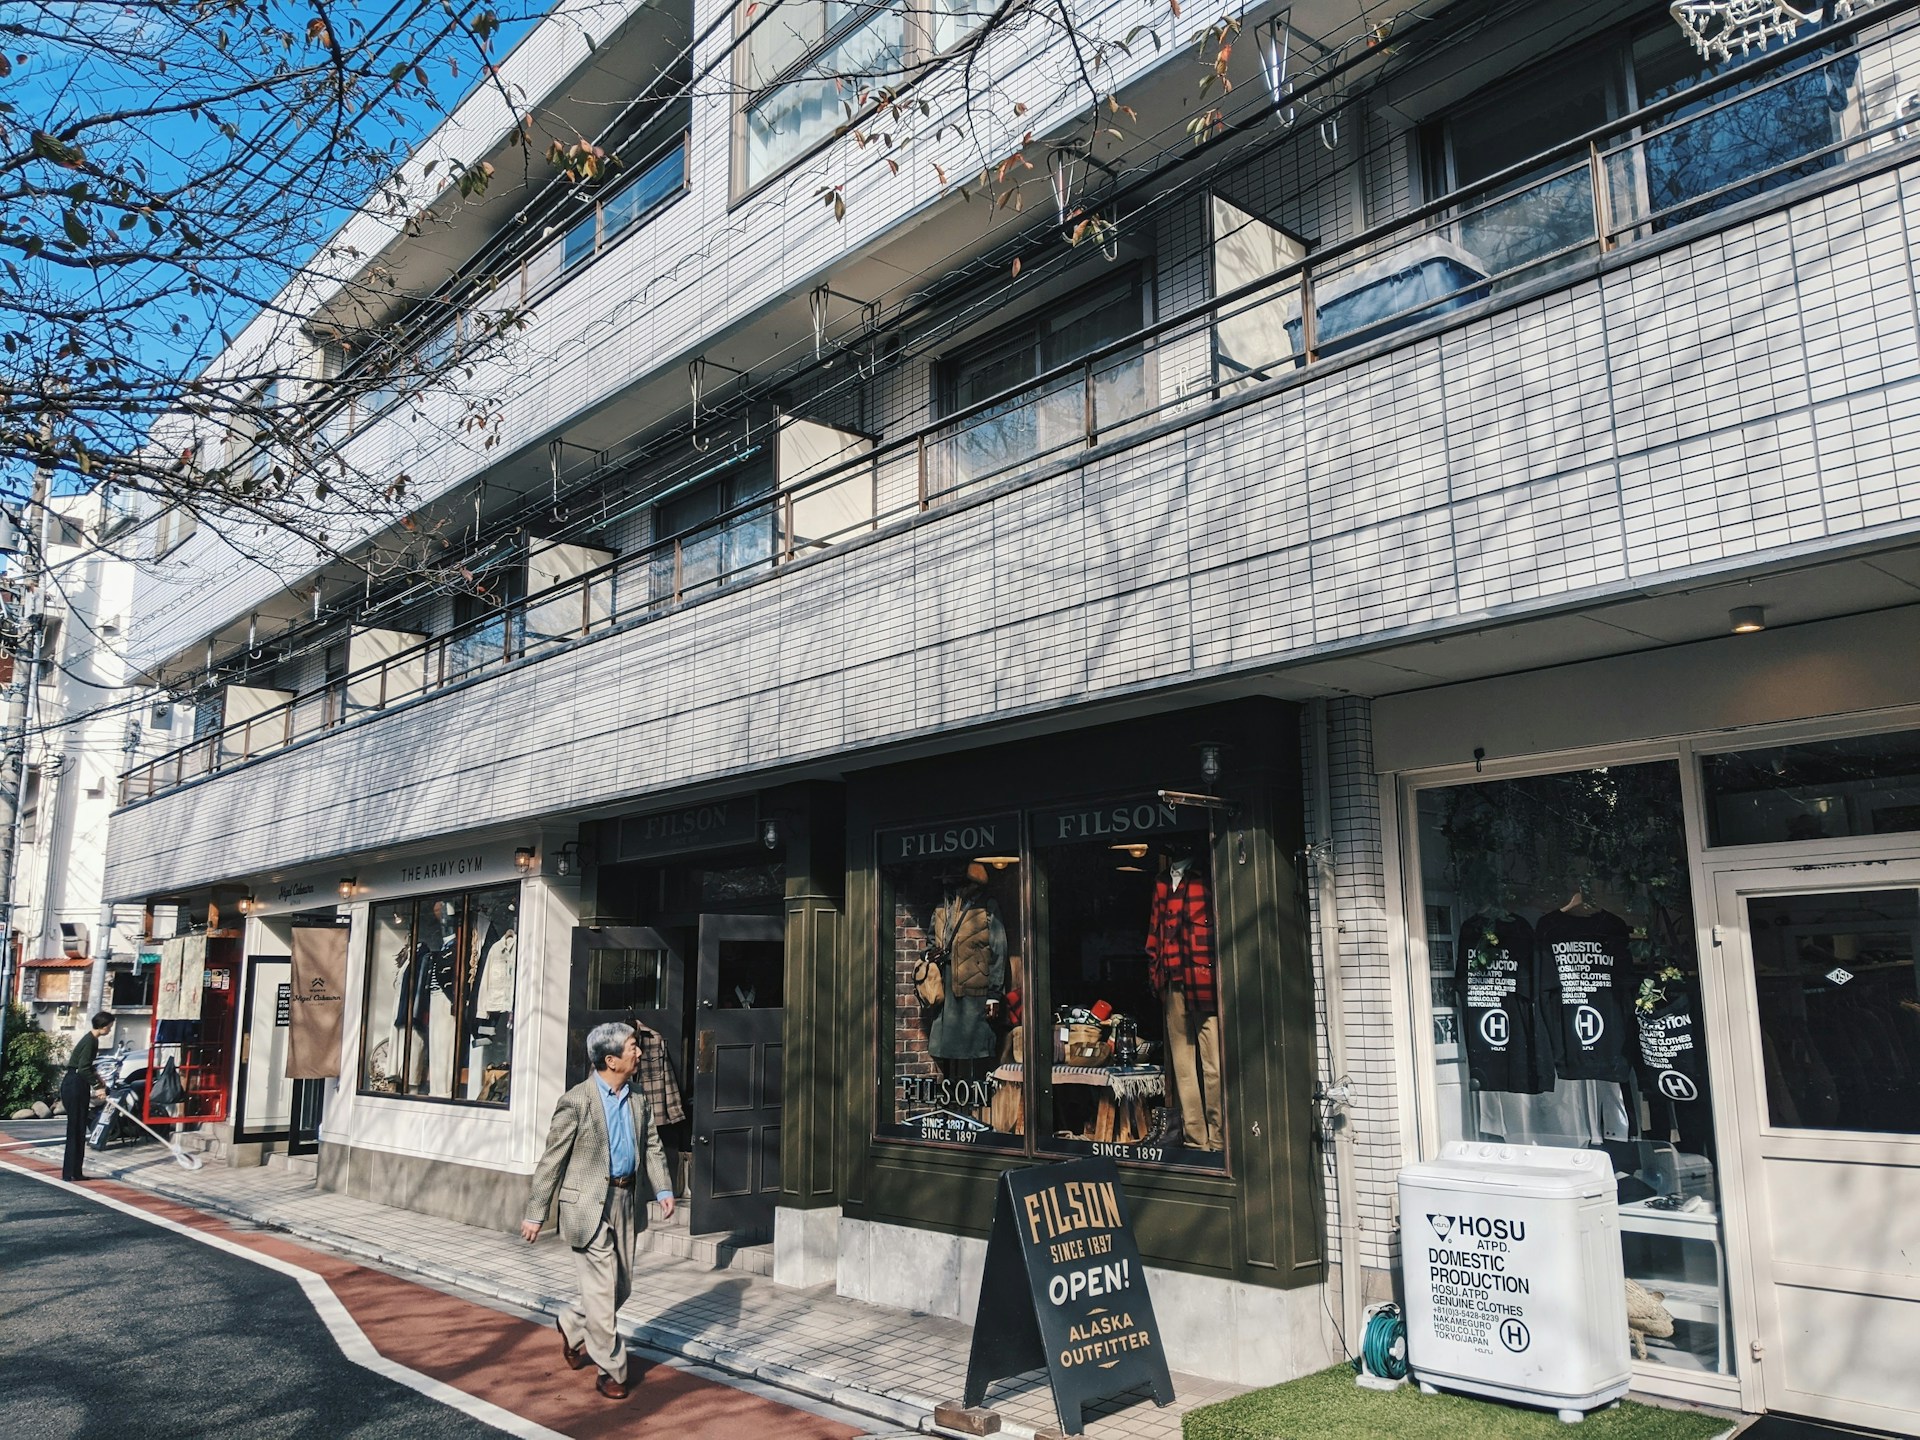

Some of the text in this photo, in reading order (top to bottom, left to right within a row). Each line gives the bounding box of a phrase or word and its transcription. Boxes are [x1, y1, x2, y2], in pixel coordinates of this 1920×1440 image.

[645, 804, 729, 840] FILSON
[1058, 803, 1178, 839] FILSON
[900, 825, 997, 857] FILSON
[402, 856, 483, 882] THE ARMY GYM
[1551, 941, 1602, 954] DOMESTIC
[1555, 954, 1614, 966] PRODUCTION
[1658, 1034, 1692, 1046] CLOTHES
[901, 1077, 991, 1107] FILSON
[921, 1128, 977, 1143] SINCE 1897
[1092, 1143, 1163, 1161] SINCE 1897
[1023, 1181, 1123, 1244] FILSON
[1458, 1215, 1526, 1242] HOSU
[1050, 1234, 1113, 1264] SINCE 1897
[1476, 1240, 1511, 1253] ATPD.
[1428, 1248, 1505, 1272] DOMESTIC
[1049, 1258, 1130, 1306] OPEN!
[1430, 1266, 1530, 1294] PRODUCTION
[1431, 1283, 1489, 1300] HOSU.ATPD
[1432, 1295, 1523, 1317] GENUINE CLOTHES
[1433, 1308, 1500, 1323] +81(0)3-5428-8239
[1069, 1312, 1135, 1343] ALASKA
[1433, 1314, 1492, 1330] NAKAMEGURO
[1434, 1322, 1486, 1337] HOSU.CO.LTD
[1060, 1331, 1151, 1368] OUTFITTER
[1435, 1330, 1489, 1346] TOKYO/JAPAN
